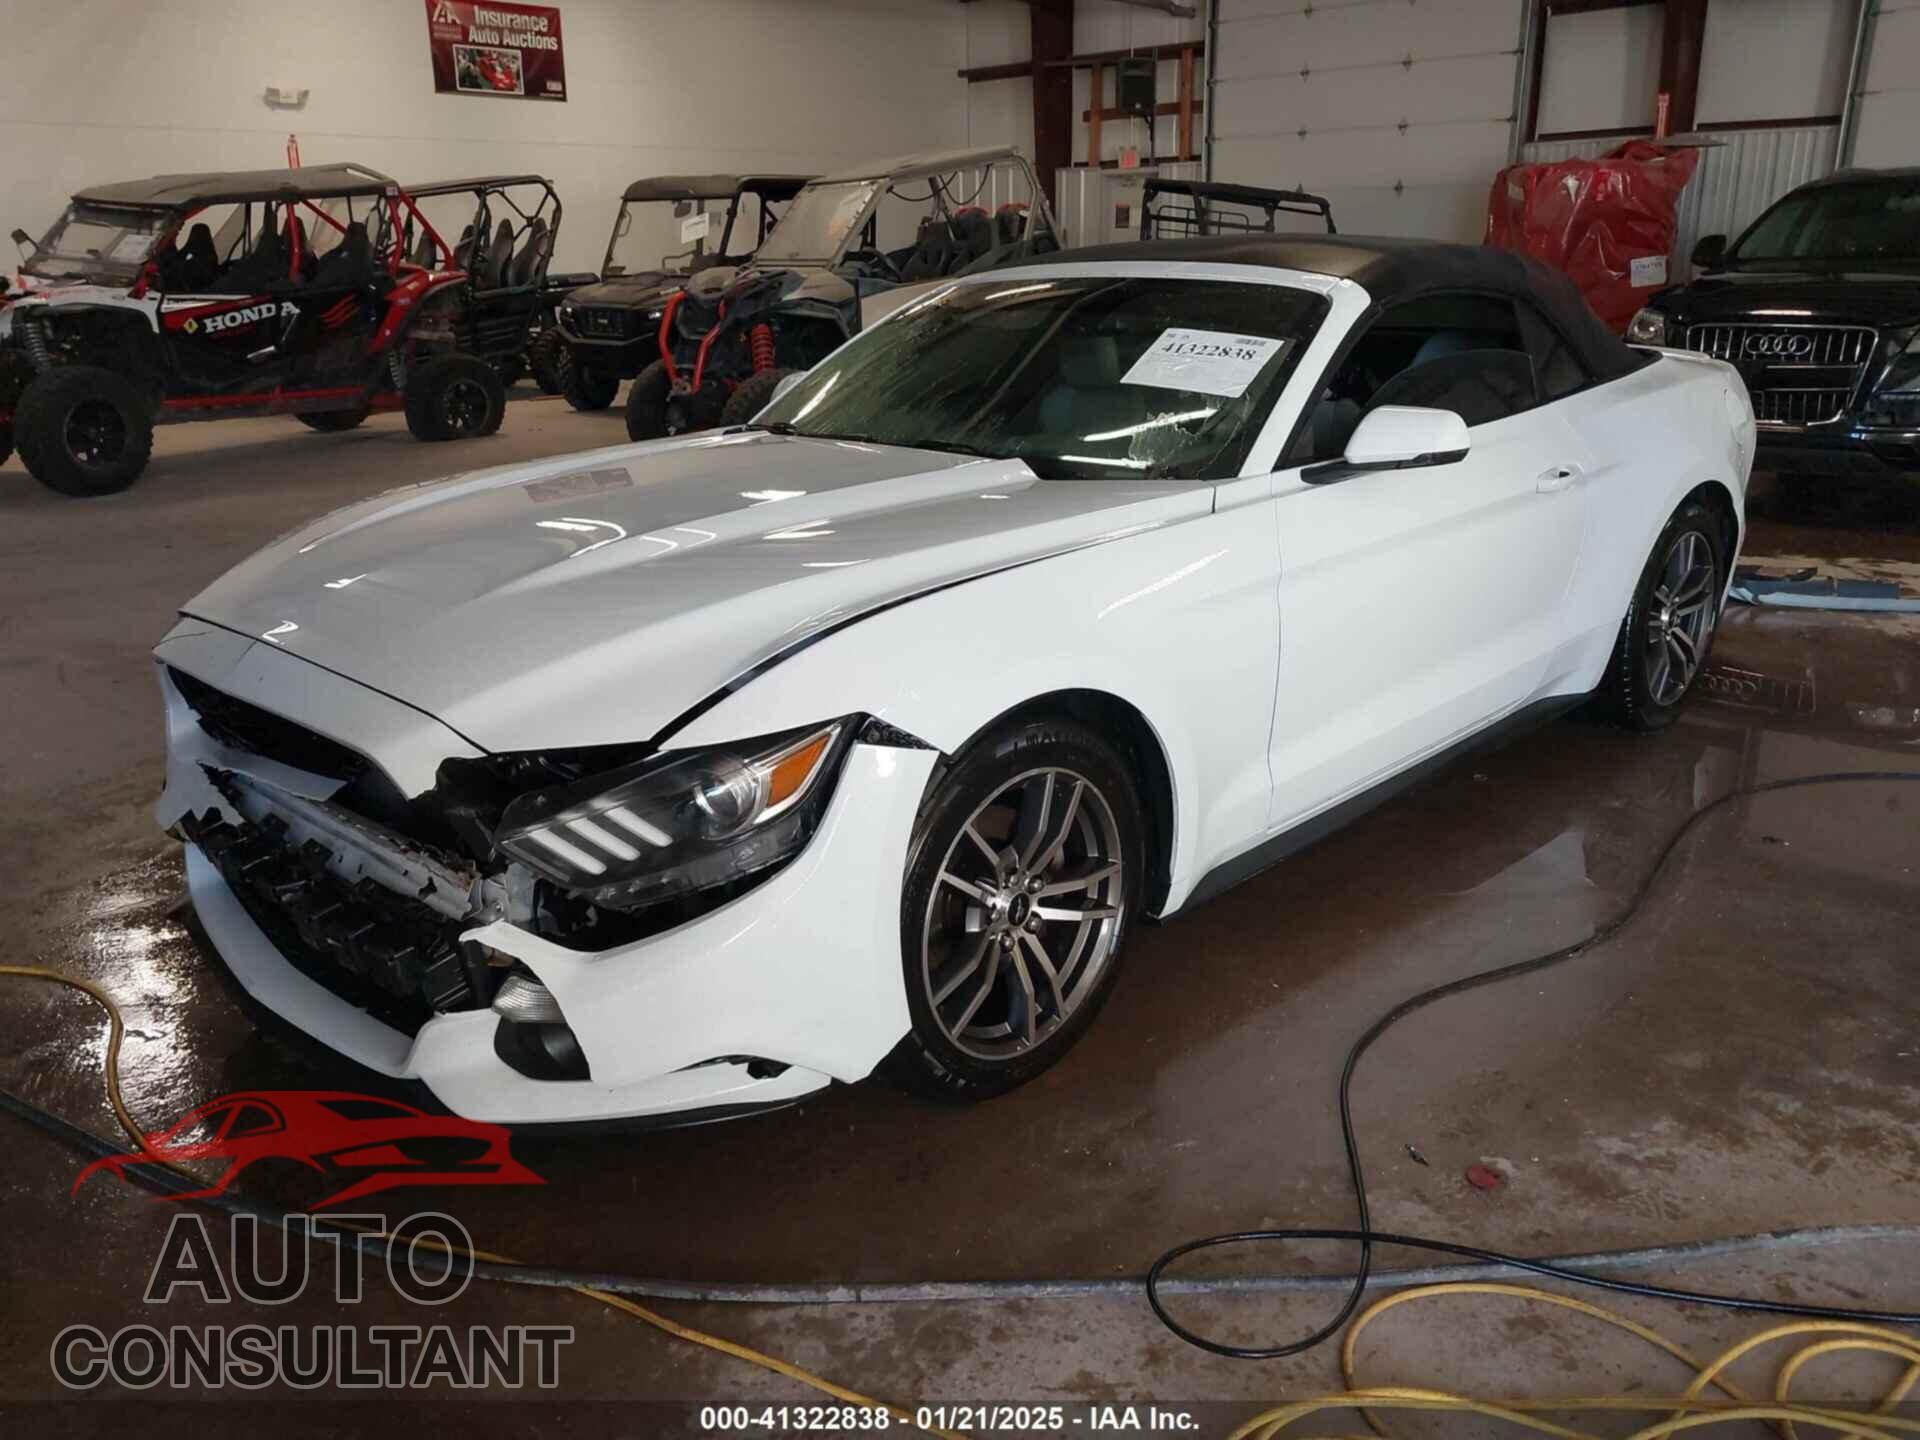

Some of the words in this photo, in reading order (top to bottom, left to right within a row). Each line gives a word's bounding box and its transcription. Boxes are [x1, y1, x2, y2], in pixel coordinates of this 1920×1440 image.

[473, 5, 549, 32] Insurance
[468, 26, 500, 45] Auto
[502, 30, 559, 50] Auctions
[203, 302, 300, 333] HONDA
[1161, 342, 1257, 361] 41322838
